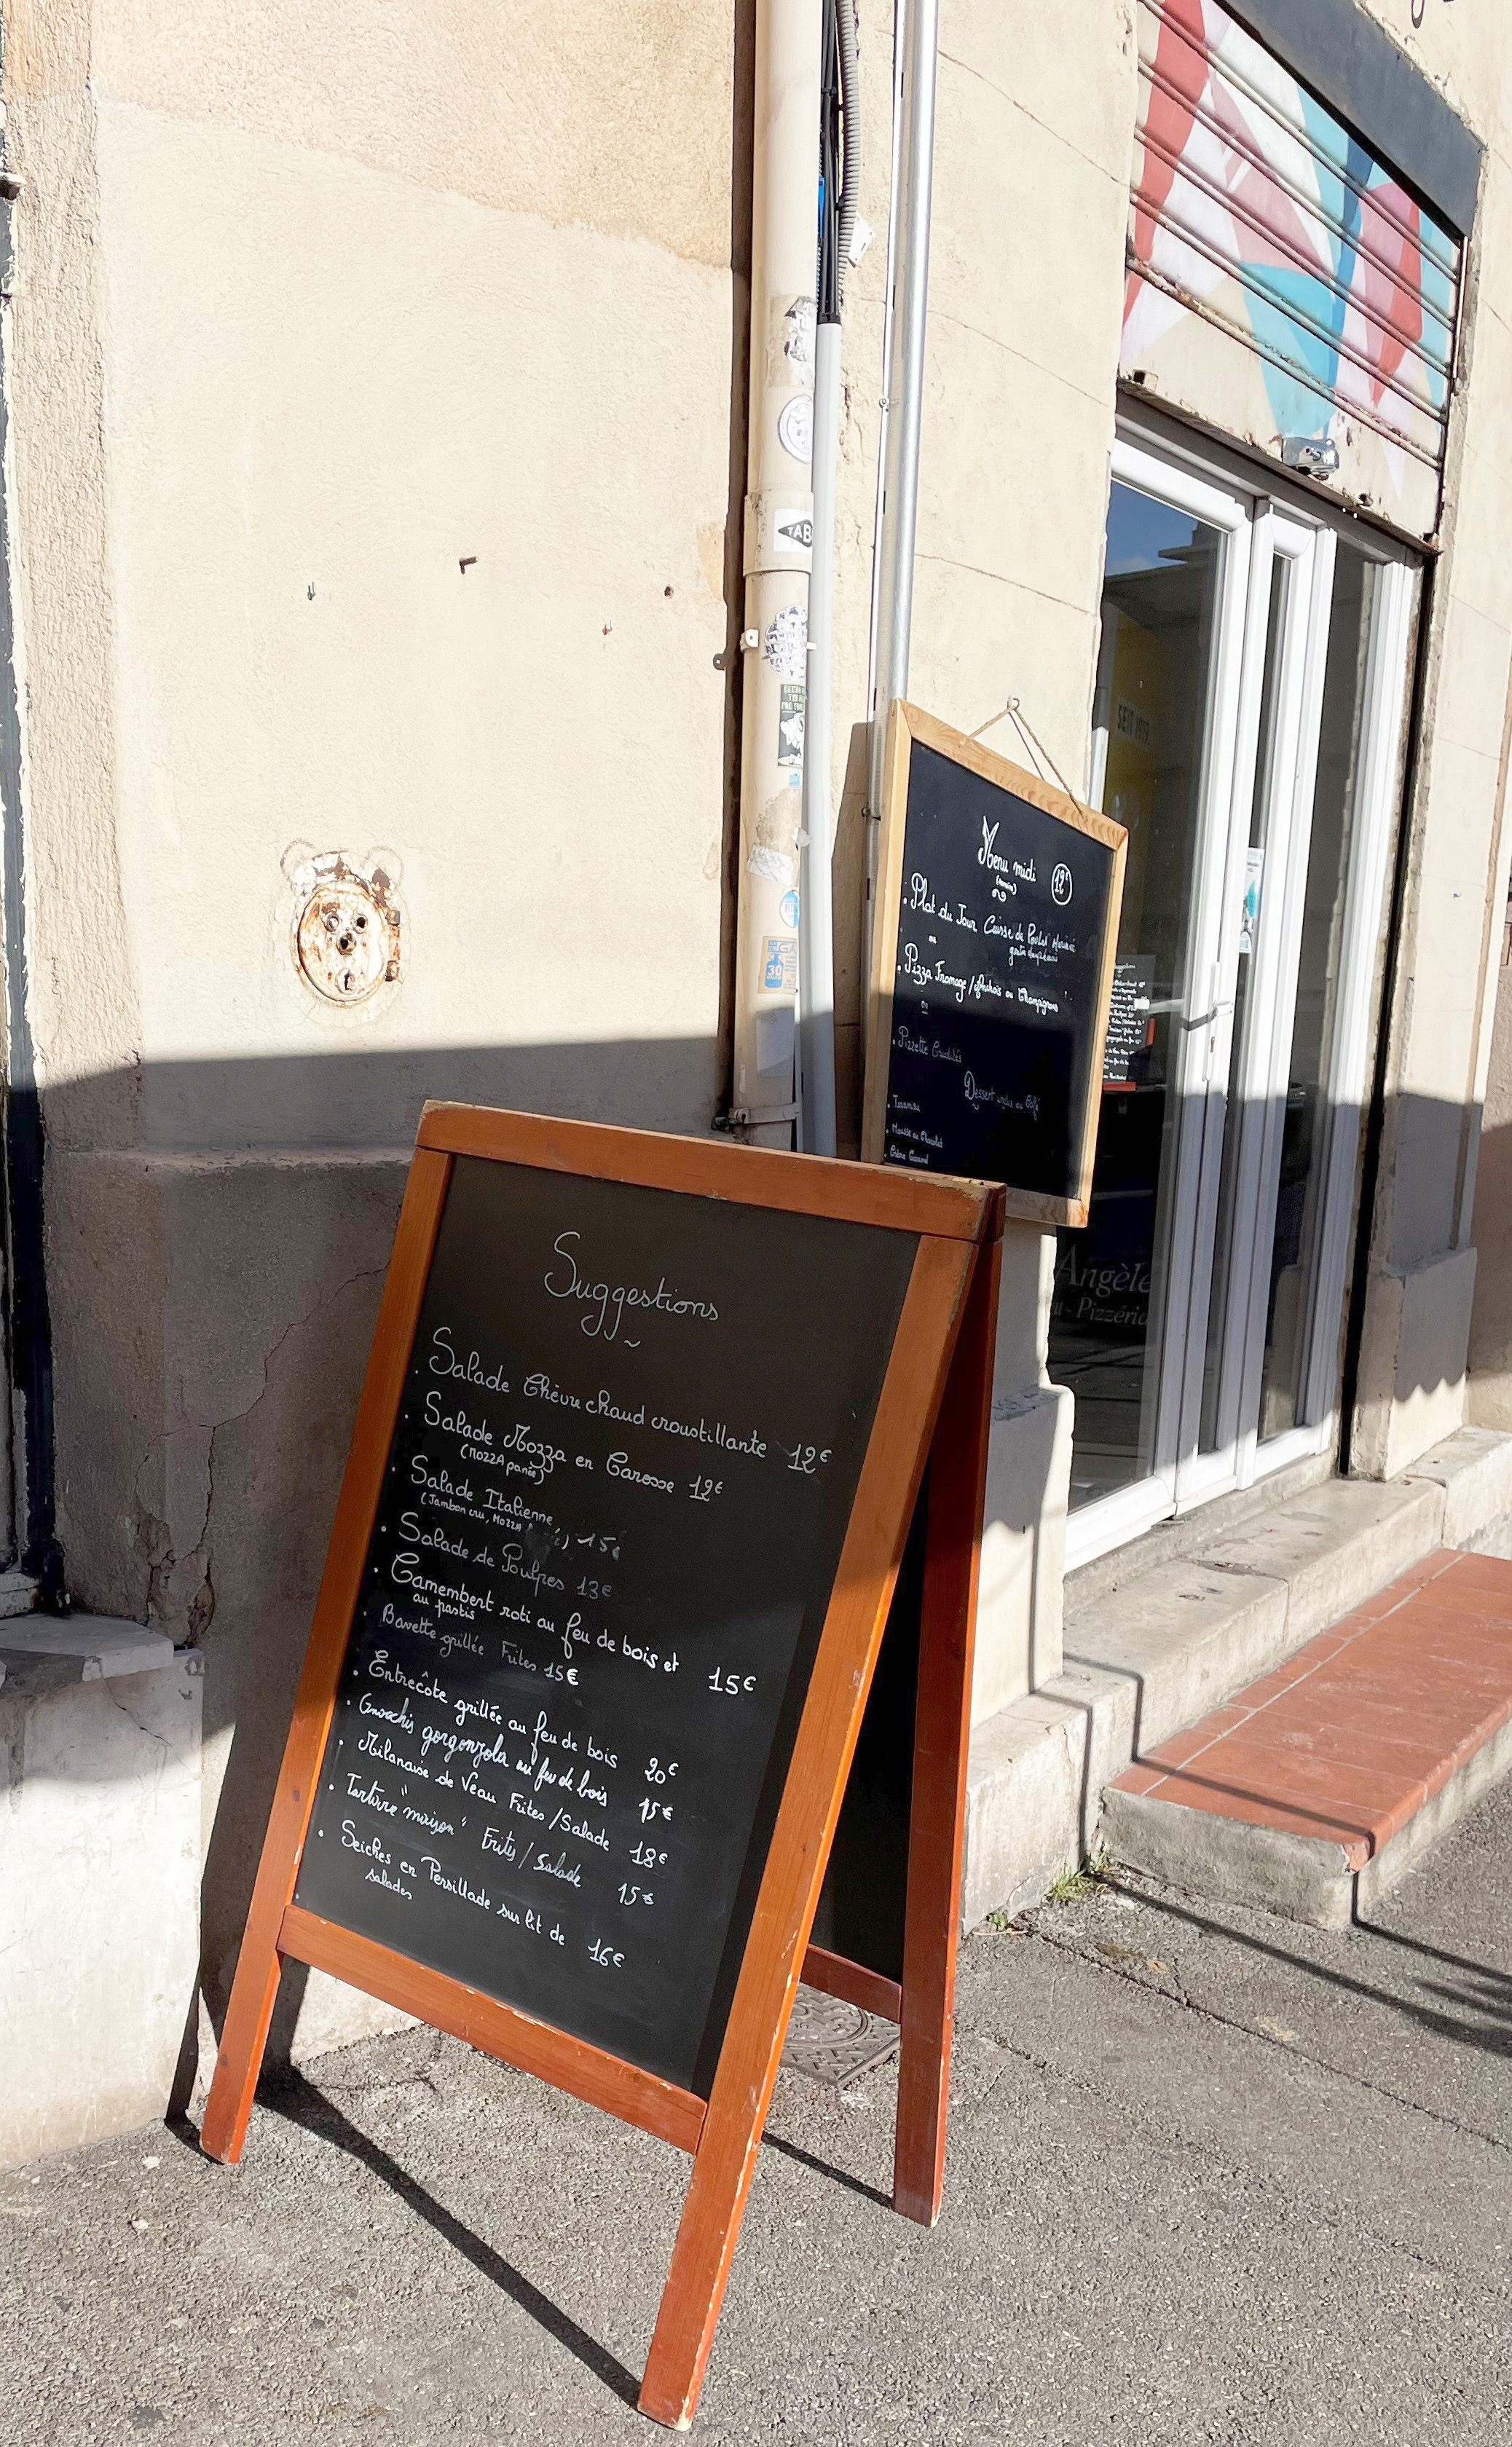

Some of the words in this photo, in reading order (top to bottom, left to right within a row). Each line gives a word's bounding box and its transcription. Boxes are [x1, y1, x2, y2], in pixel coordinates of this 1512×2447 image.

[977, 815, 1009, 873] Menu
[1013, 859, 1036, 882] midi
[910, 872, 935, 913] Plat
[938, 902, 953, 922] du
[956, 903, 977, 933] Jour
[984, 915, 1014, 939] Cuisse
[1015, 923, 1025, 942] de
[929, 934, 937, 945] ou
[905, 942, 932, 985] Pizza
[935, 960, 967, 1003] Fromage
[1005, 990, 1014, 999] ou
[897, 1025, 929, 1055] Pizzette
[964, 1071, 996, 1101] Dessert
[892, 1122, 911, 1137] Mousse
[544, 1231, 719, 1340] Suggestions
[430, 1326, 510, 1392] Salade
[524, 1374, 580, 1408] Chèvre
[586, 1390, 645, 1425] chaud
[651, 1418, 767, 1458] croustillante
[787, 1443, 832, 1474] 12€
[425, 1391, 492, 1445] Salade
[503, 1423, 567, 1473] Mozza
[575, 1456, 594, 1470] en
[606, 1451, 674, 1493] Carosse
[689, 1475, 723, 1502] 12€
[411, 1455, 473, 1501] Salade
[483, 1489, 554, 1526] Italienne
[421, 1492, 466, 1514] (Jambon
[399, 1512, 470, 1559] Salade
[473, 1546, 495, 1567] de
[502, 1543, 564, 1596] Poulpes
[382, 1604, 436, 1639] Bavette
[439, 1632, 484, 1658] grillée
[391, 1553, 494, 1612] Camembert
[500, 1605, 531, 1624] roti
[538, 1618, 554, 1632] au
[562, 1612, 591, 1659] feu
[596, 1629, 615, 1652] de
[622, 1635, 658, 1668] bois
[664, 1652, 679, 1672] et
[708, 1667, 757, 1695] 15€
[413, 1593, 429, 1605] au
[435, 1599, 475, 1620] pastis
[369, 1650, 448, 1703] Entrecôte
[454, 1699, 503, 1726] grillée
[508, 1719, 527, 1734] au
[530, 1710, 557, 1765] feu
[562, 1732, 578, 1751] de
[587, 1736, 618, 1769] bois
[358, 1693, 414, 1734] Gnocchis
[422, 1725, 509, 1768] gorgonzola
[516, 1760, 532, 1776] au
[534, 1757, 556, 1792] feu
[558, 1767, 574, 1791] de
[577, 1770, 607, 1807] bois
[358, 1731, 430, 1778] Milanaise
[435, 1770, 454, 1789] de
[461, 1771, 496, 1804] Veau
[509, 1792, 545, 1821] Frites
[629, 1840, 668, 1868] 18€
[341, 1819, 392, 1865] Seiches
[400, 1861, 417, 1878] en
[420, 1856, 491, 1910] Persillade
[496, 1903, 521, 1925] sur
[525, 1909, 542, 1934] lit
[550, 1923, 565, 1946] de
[588, 1938, 625, 1968] 16€
[365, 1868, 412, 1900] salades
[533, 1852, 582, 1888] Salade
